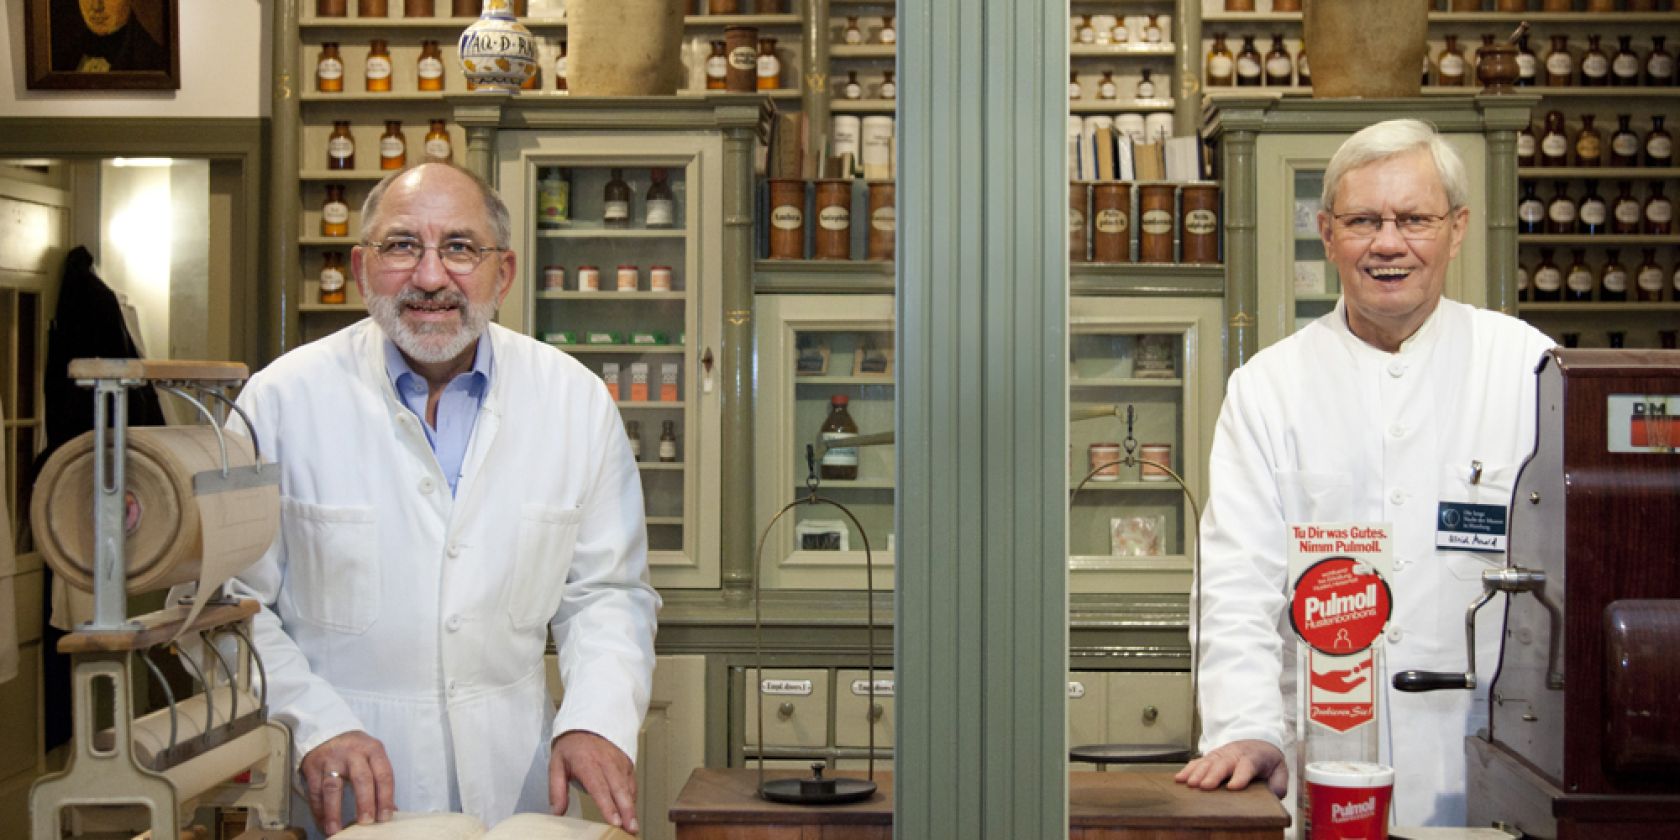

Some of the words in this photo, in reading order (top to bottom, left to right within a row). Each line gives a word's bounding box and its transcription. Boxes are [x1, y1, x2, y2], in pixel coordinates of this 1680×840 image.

[1632, 402, 1666, 416] DM
[1293, 527, 1306, 539] Tu
[1308, 527, 1325, 539] Dir
[1326, 529, 1349, 539] was
[1350, 527, 1388, 539] Gutes.
[1300, 540, 1333, 553] Nimm
[1336, 540, 1382, 553] Pulmoll.
[1305, 583, 1377, 621] Pulmoll
[1305, 607, 1377, 630] Hustenbonbons
[1331, 795, 1377, 819] Pulmoll
